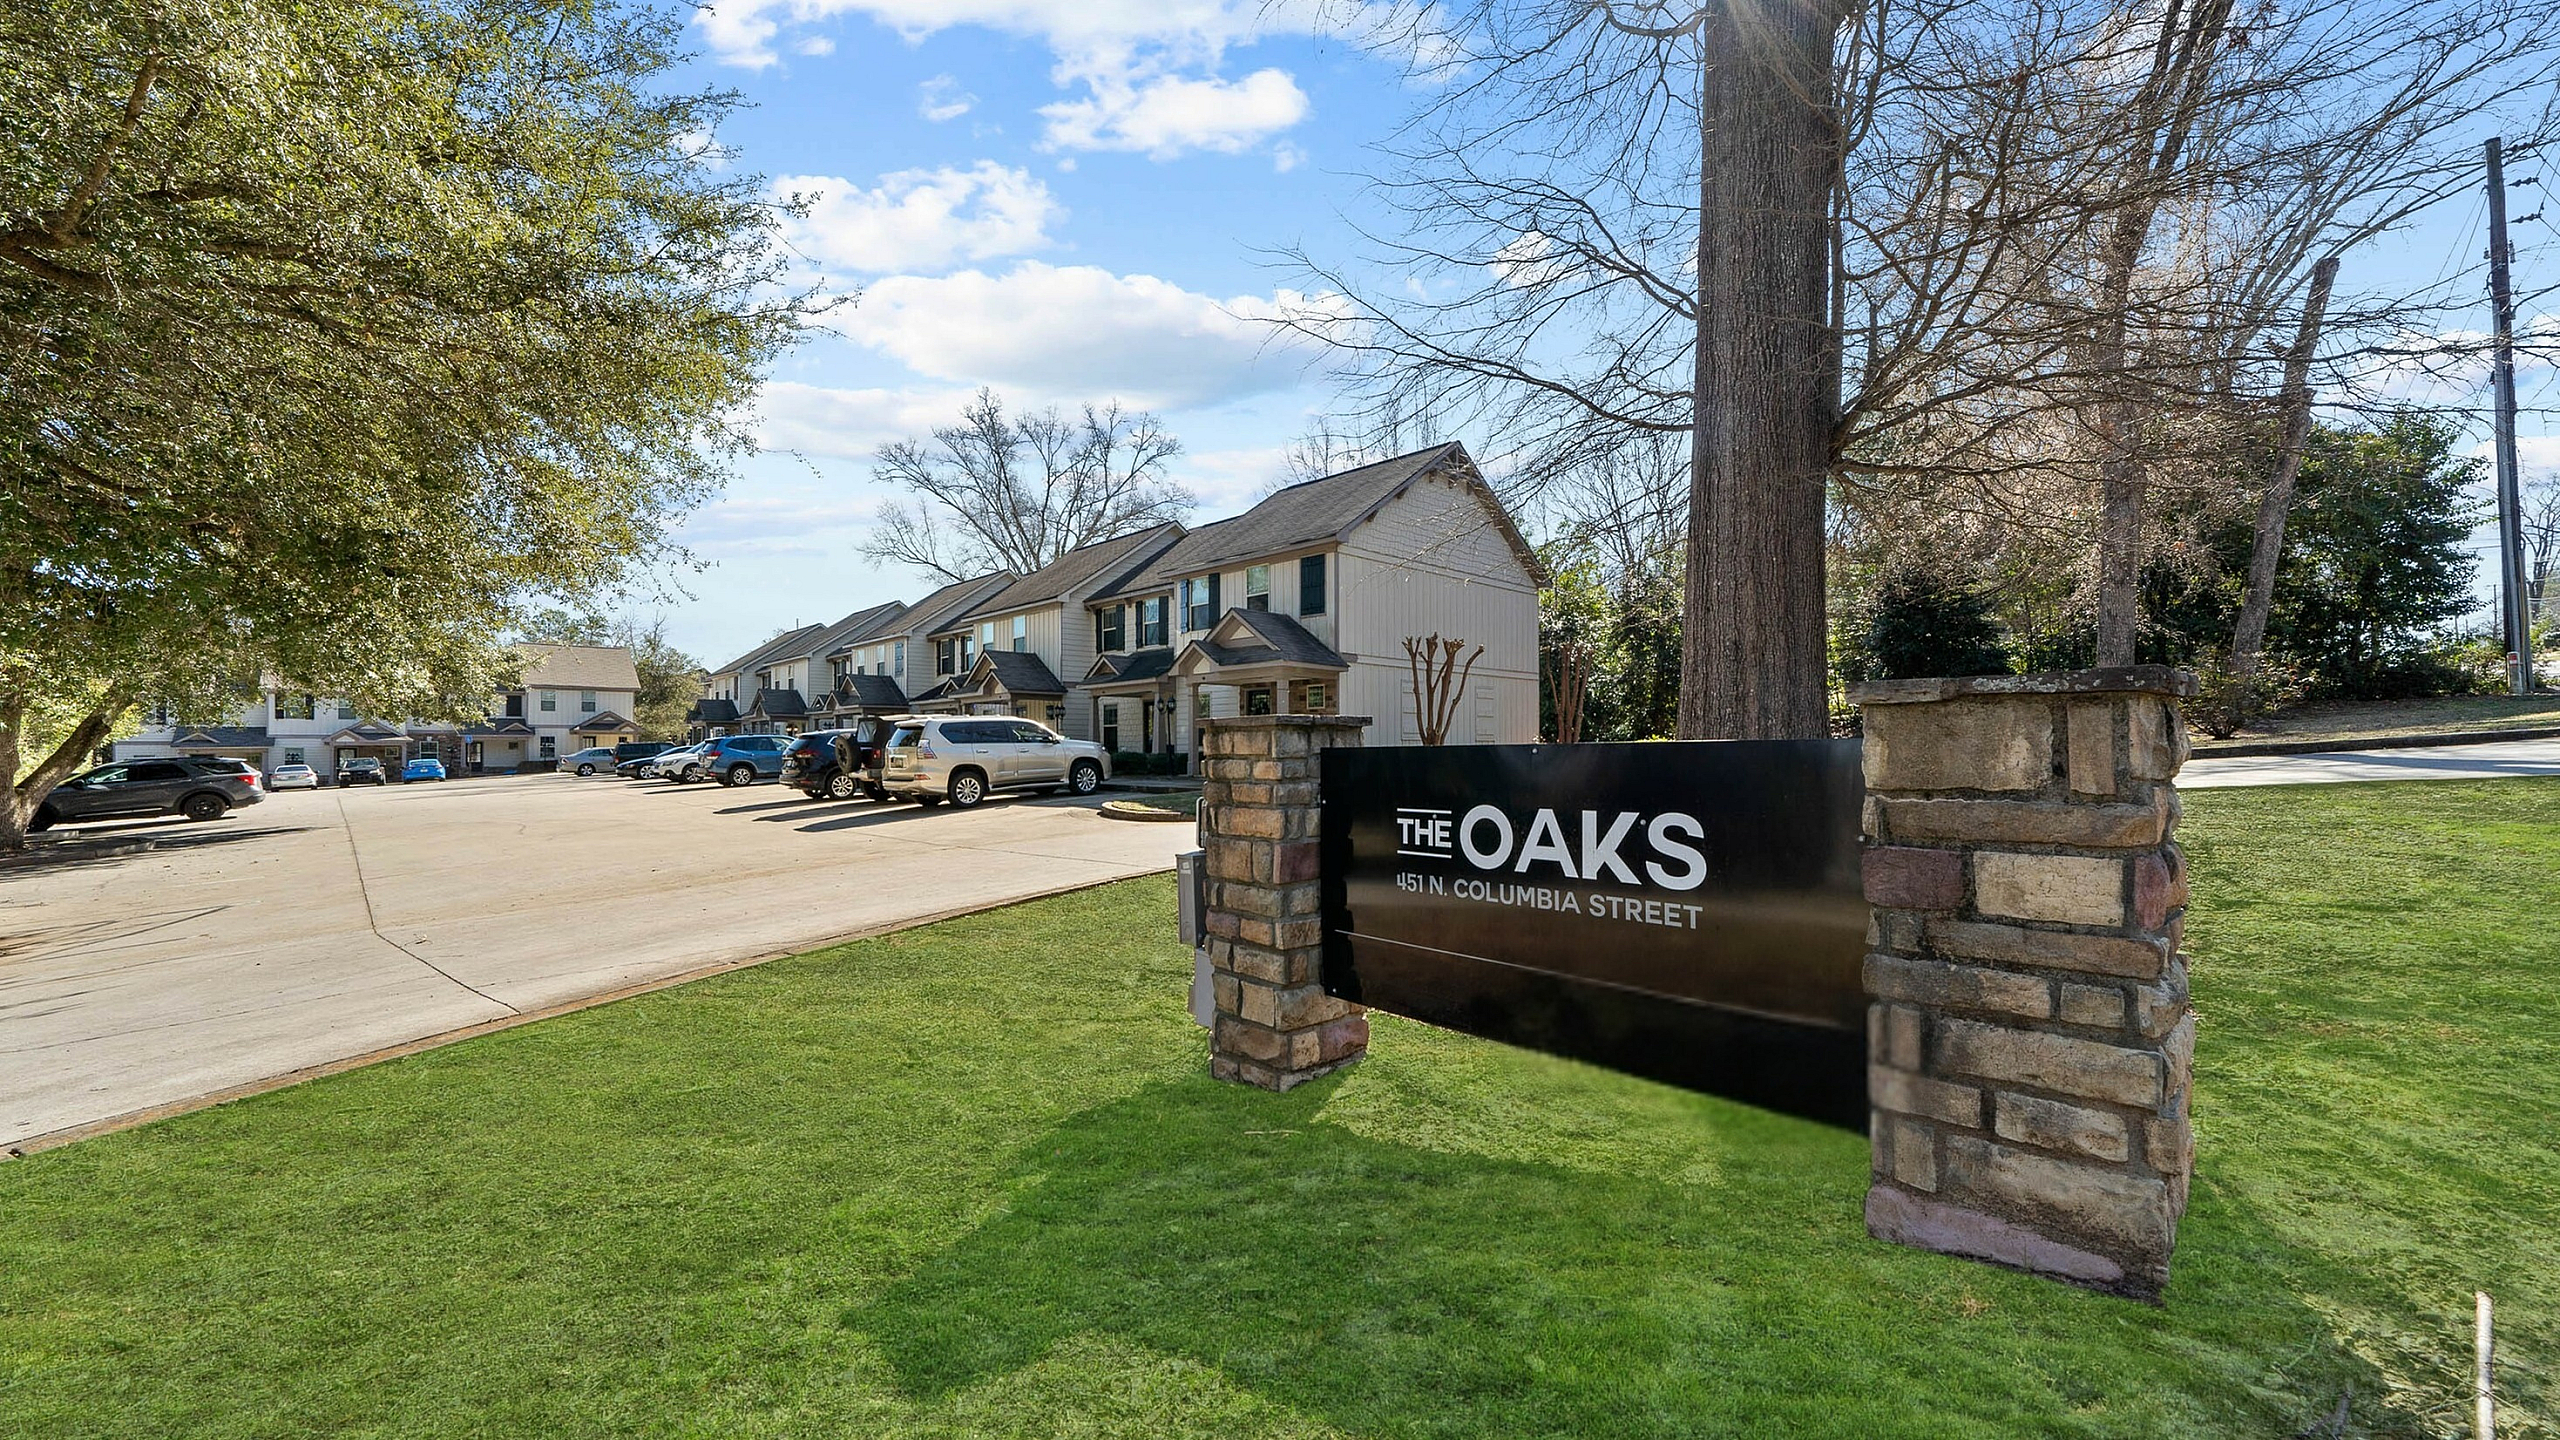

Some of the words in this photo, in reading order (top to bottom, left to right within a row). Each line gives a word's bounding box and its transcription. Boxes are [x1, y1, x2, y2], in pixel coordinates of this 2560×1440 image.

[1396, 817, 1452, 848] THE
[1459, 804, 1708, 891] OAKS
[1396, 872, 1423, 893] 451
[1429, 875, 1447, 896] N.
[1453, 879, 1581, 914] COLUMBIA
[1589, 894, 1703, 930] STREET
